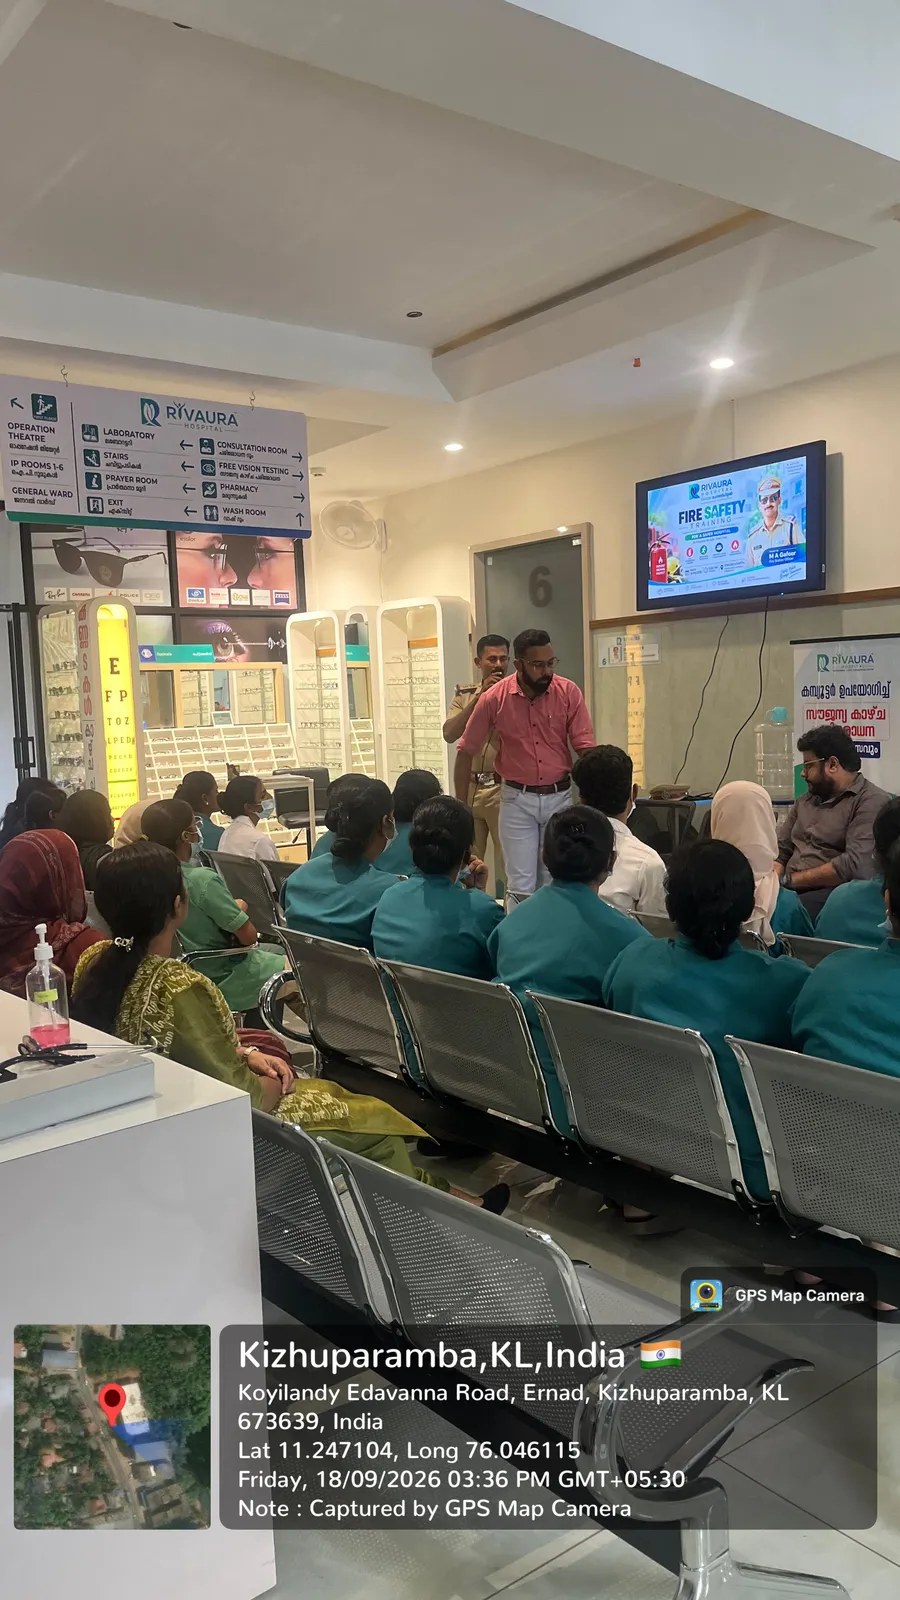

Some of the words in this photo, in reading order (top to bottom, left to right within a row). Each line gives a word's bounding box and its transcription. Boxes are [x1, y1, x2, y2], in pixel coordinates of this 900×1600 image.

[167, 401, 238, 426] RIVAURA
[8, 422, 55, 434] OPERATION
[103, 428, 155, 440] LABORATORY
[184, 424, 223, 432] HOSPITAL
[8, 432, 46, 442] THEATRE
[217, 441, 266, 452] CONSULTATION
[268, 446, 287, 455] ROOM
[21, 461, 51, 470] ROOMS
[219, 462, 236, 471] FREE
[238, 464, 261, 473] VISION
[262, 466, 289, 475] TESTING
[106, 475, 134, 483] PRAYER
[136, 476, 158, 484] ROOM
[701, 478, 732, 492] RIVAURA
[12, 487, 48, 496] GENERAL
[50, 490, 73, 498] WARD
[220, 484, 258, 493] PHARMACY
[679, 508, 702, 525] FIRE
[704, 499, 746, 519] SAFETY
[690, 516, 732, 529] TRAINING
[529, 566, 552, 608] 6
[832, 653, 874, 664] RIVAURA
[109, 657, 120, 674] E
[840, 680, 891, 699] ഉപയോഗിച്ച്
[851, 706, 886, 720] കാഴ്ച
